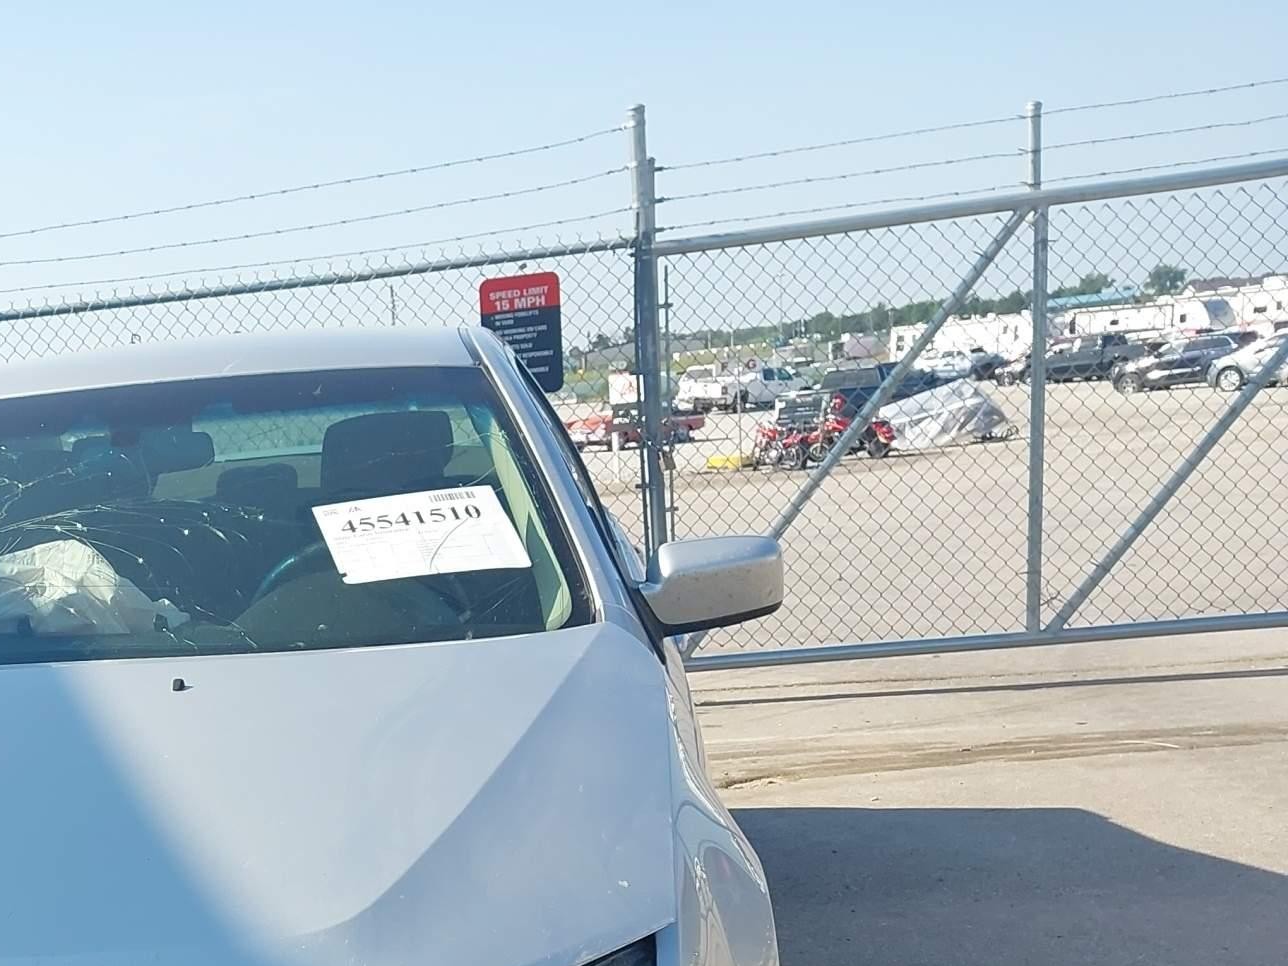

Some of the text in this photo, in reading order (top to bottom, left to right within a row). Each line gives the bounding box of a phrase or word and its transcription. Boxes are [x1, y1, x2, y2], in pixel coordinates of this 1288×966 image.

[489, 286, 548, 300] SPEED LIMIT
[495, 295, 545, 311] 15 MPH
[341, 504, 482, 534] 45541510
